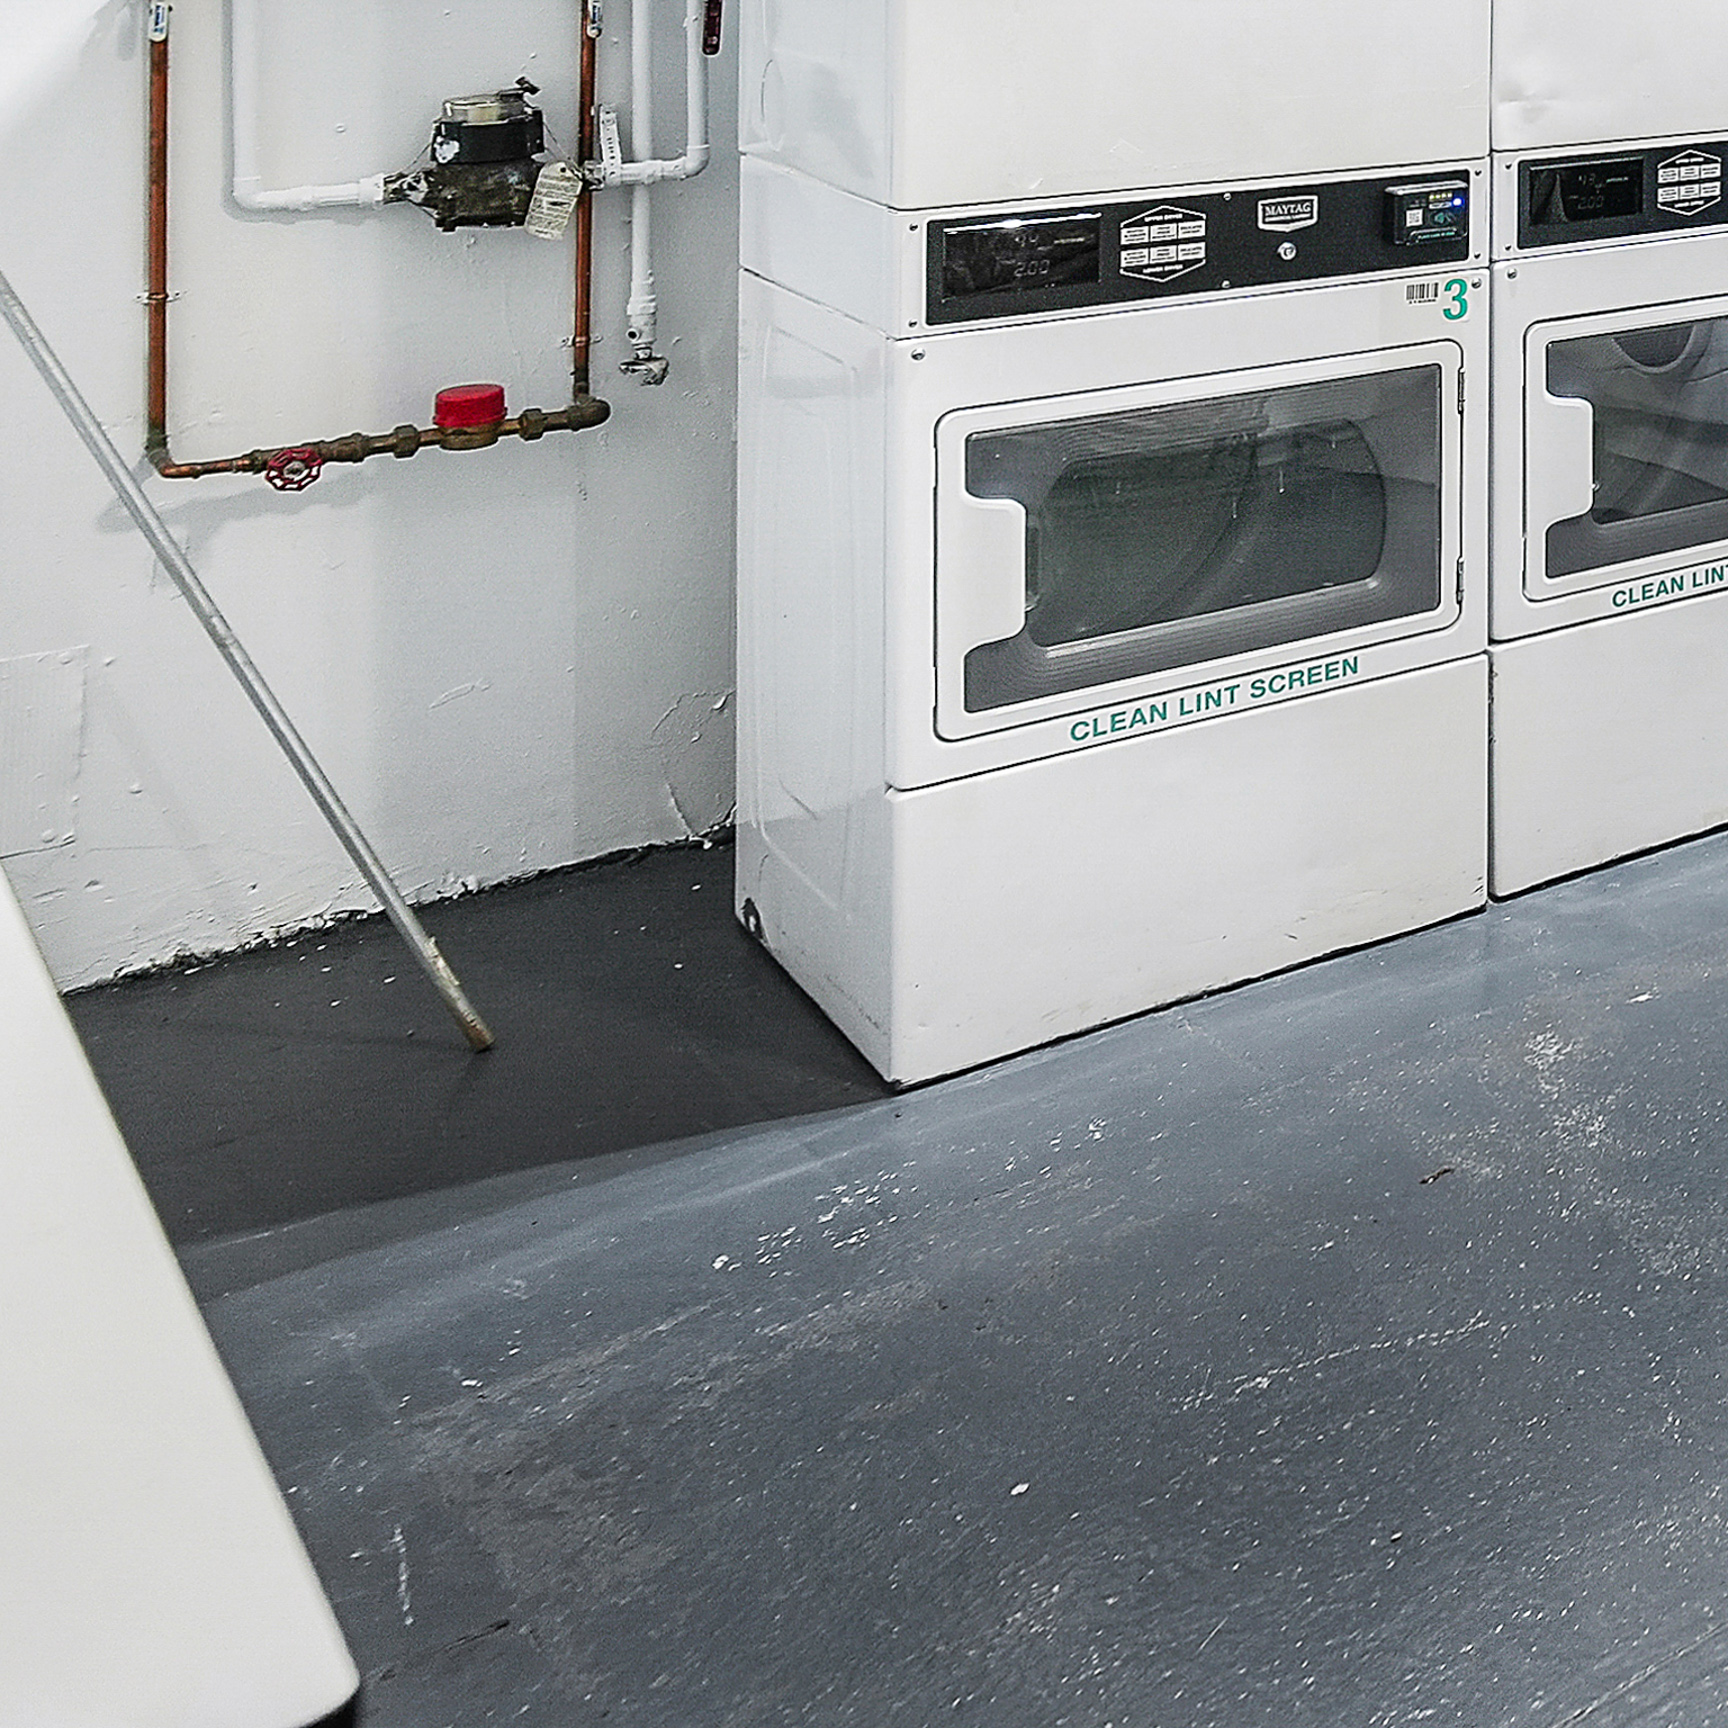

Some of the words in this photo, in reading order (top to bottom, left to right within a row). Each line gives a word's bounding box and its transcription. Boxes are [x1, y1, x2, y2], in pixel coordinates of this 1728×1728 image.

[1265, 201, 1312, 217] MAYTAG
[1443, 278, 1468, 320] 3
[1612, 574, 1684, 608] CLEAN
[1070, 700, 1168, 742] CLEAN
[1179, 684, 1241, 717] LINT
[1249, 656, 1359, 699] SCREEN
